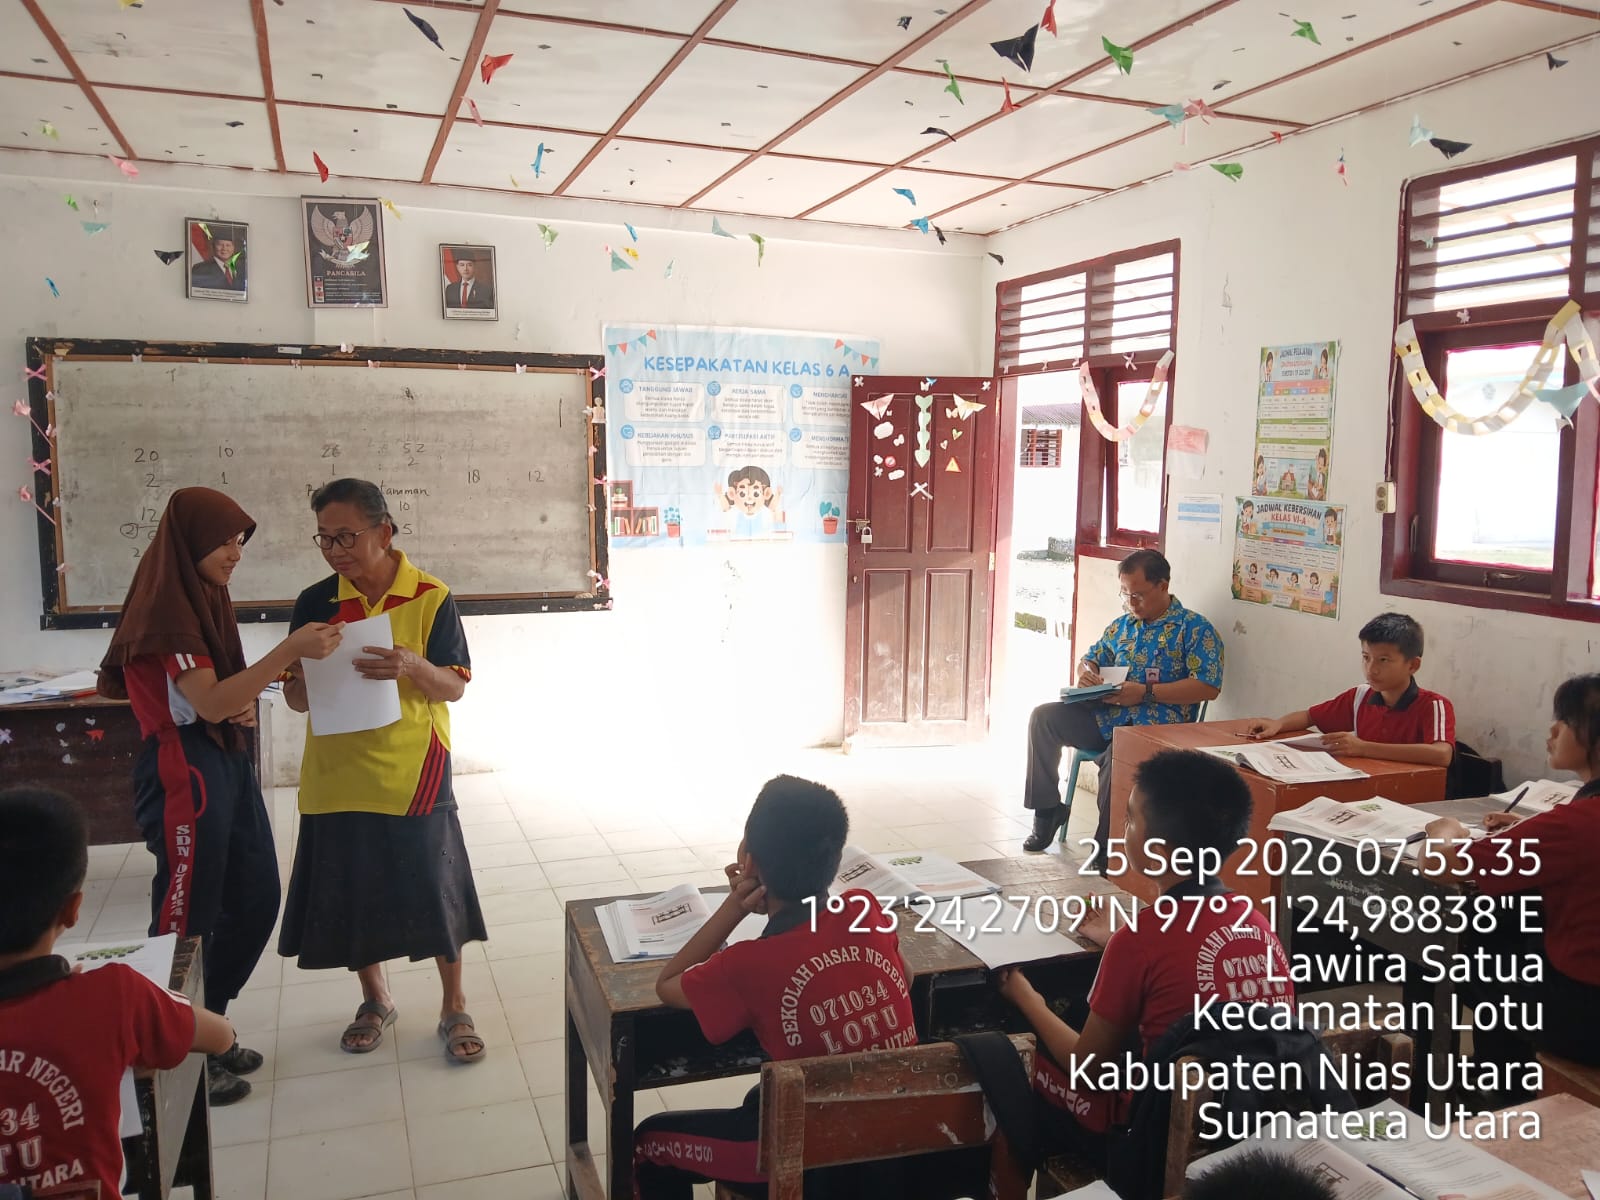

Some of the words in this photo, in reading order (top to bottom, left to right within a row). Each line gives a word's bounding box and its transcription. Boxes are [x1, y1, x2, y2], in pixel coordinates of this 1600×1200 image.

[643, 355, 769, 375] KESEPAKATAN
[772, 360, 821, 377] KELAS
[825, 363, 834, 377] 6
[838, 366, 850, 378] A
[134, 448, 159, 463] 20
[218, 445, 234, 459] 10
[146, 473, 161, 487] 2
[221, 472, 229, 485] 1
[528, 470, 545, 482] 12
[141, 506, 159, 522] 12
[399, 501, 411, 512] 10
[1256, 503, 1282, 514] JADWAL
[1283, 503, 1322, 520] KEBERSIHAN
[1271, 513, 1291, 522] KELAS
[1292, 515, 1307, 525] VI-A
[176, 824, 191, 857] SDN
[1197, 930, 1227, 993] SEKOLAH
[781, 964, 815, 1047] SEKOLAH
[810, 945, 860, 972] DASAR
[865, 947, 909, 999] NEGERI
[809, 979, 889, 1026] 071034
[820, 1004, 899, 1056] LOTU
[25, 1055, 85, 1131] NEGERI
